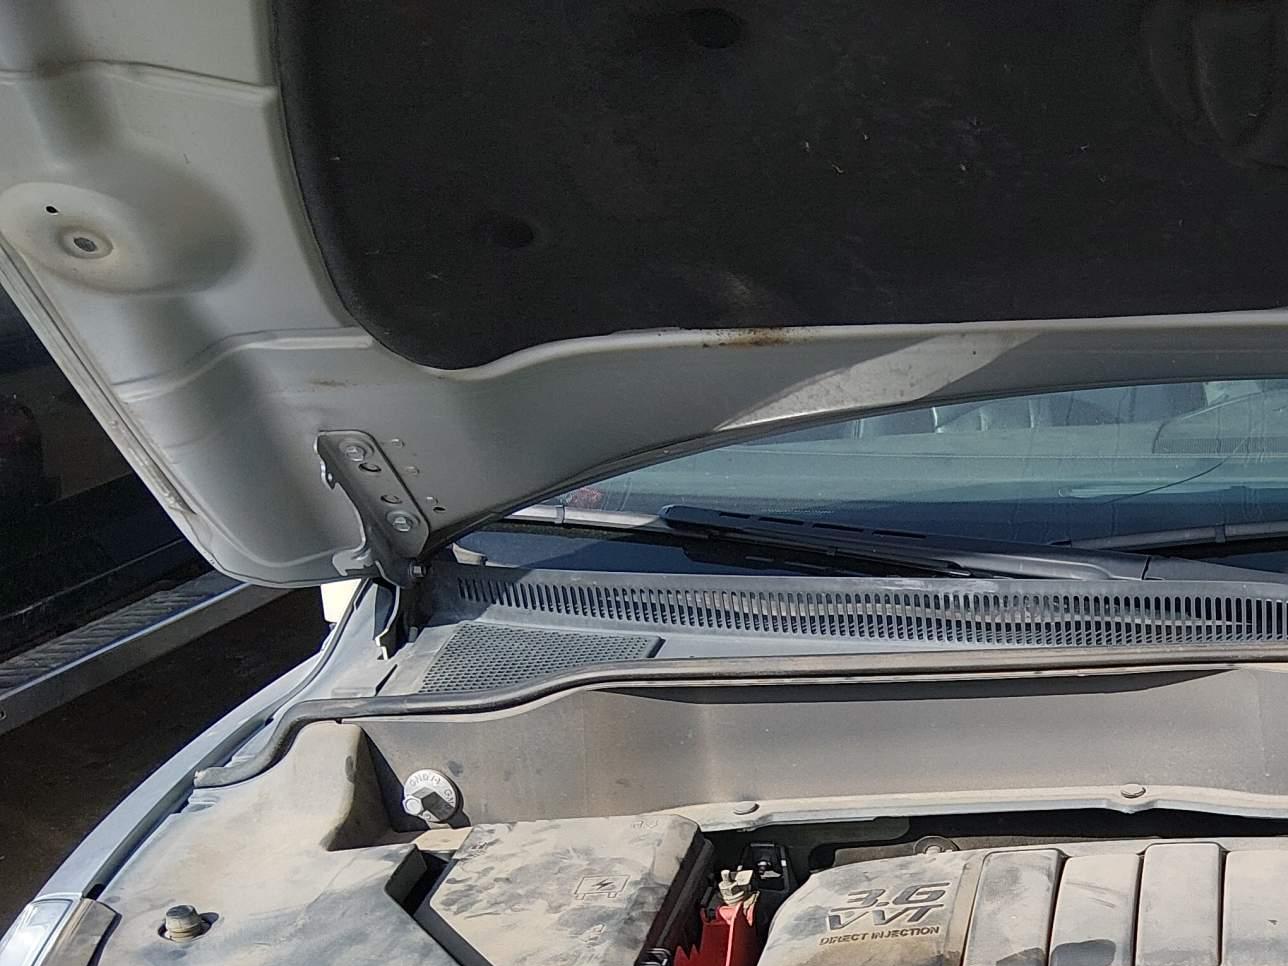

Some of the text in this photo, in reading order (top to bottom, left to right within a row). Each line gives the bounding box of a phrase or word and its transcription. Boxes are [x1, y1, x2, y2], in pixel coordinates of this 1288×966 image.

[836, 881, 950, 910] 3.6
[828, 903, 944, 930] VVT
[819, 926, 940, 945] DIRECT INJECTION
